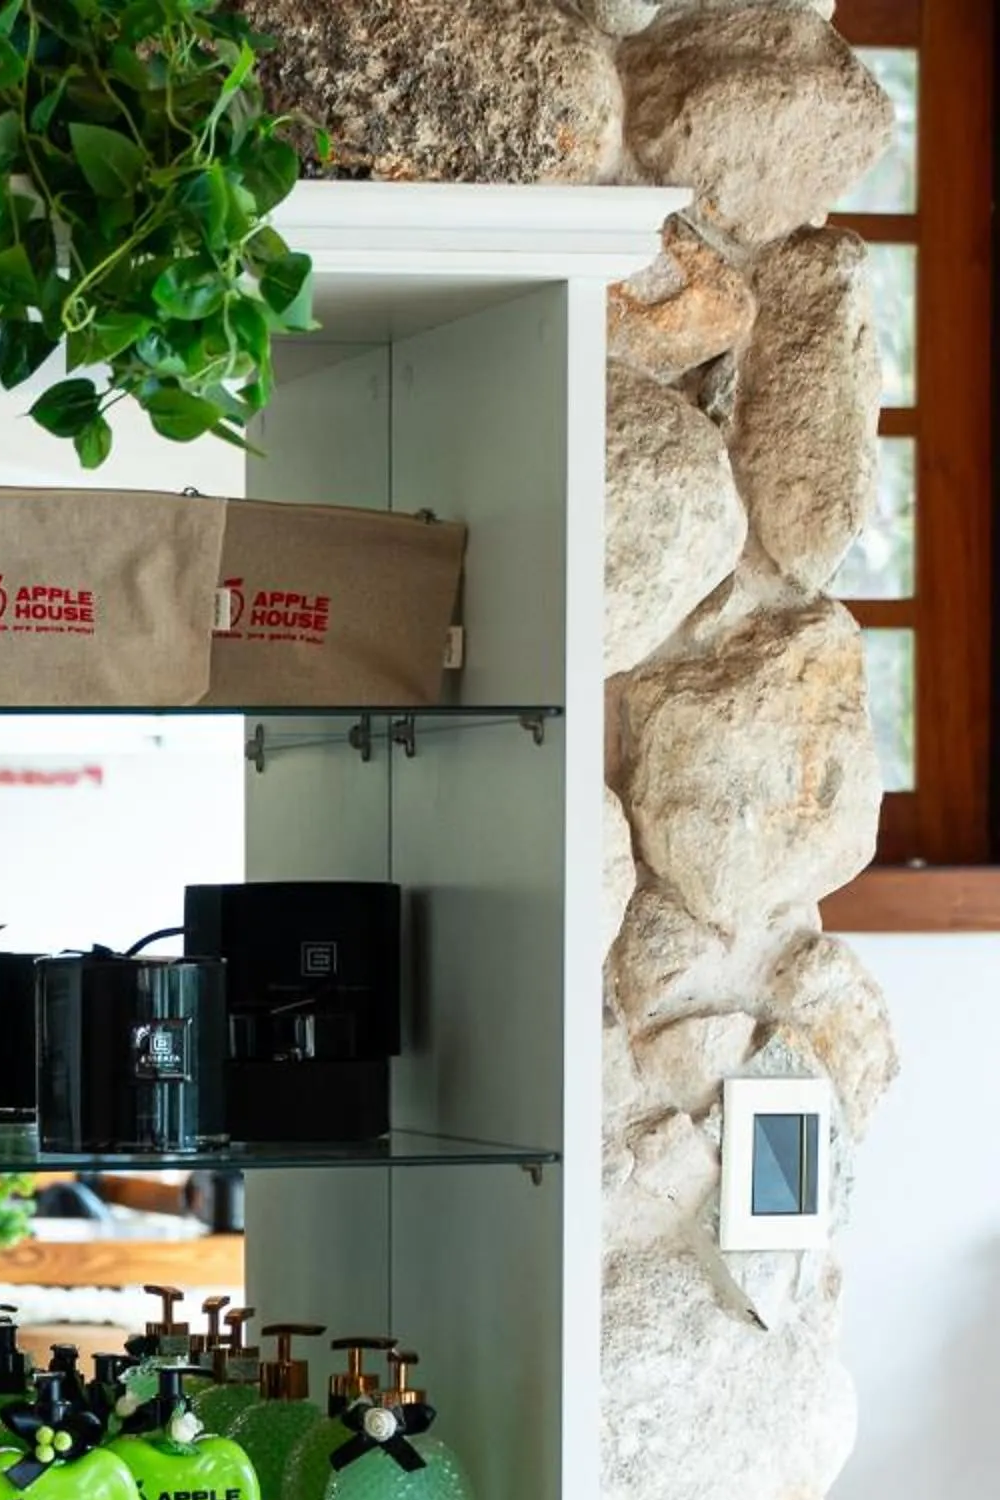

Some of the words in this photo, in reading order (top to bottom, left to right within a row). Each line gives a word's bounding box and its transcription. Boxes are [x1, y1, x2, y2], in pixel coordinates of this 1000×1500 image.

[16, 586, 93, 606] APPLE
[254, 591, 331, 613] APPLE
[15, 604, 94, 622] HOUSE
[250, 610, 329, 631] HOUSE
